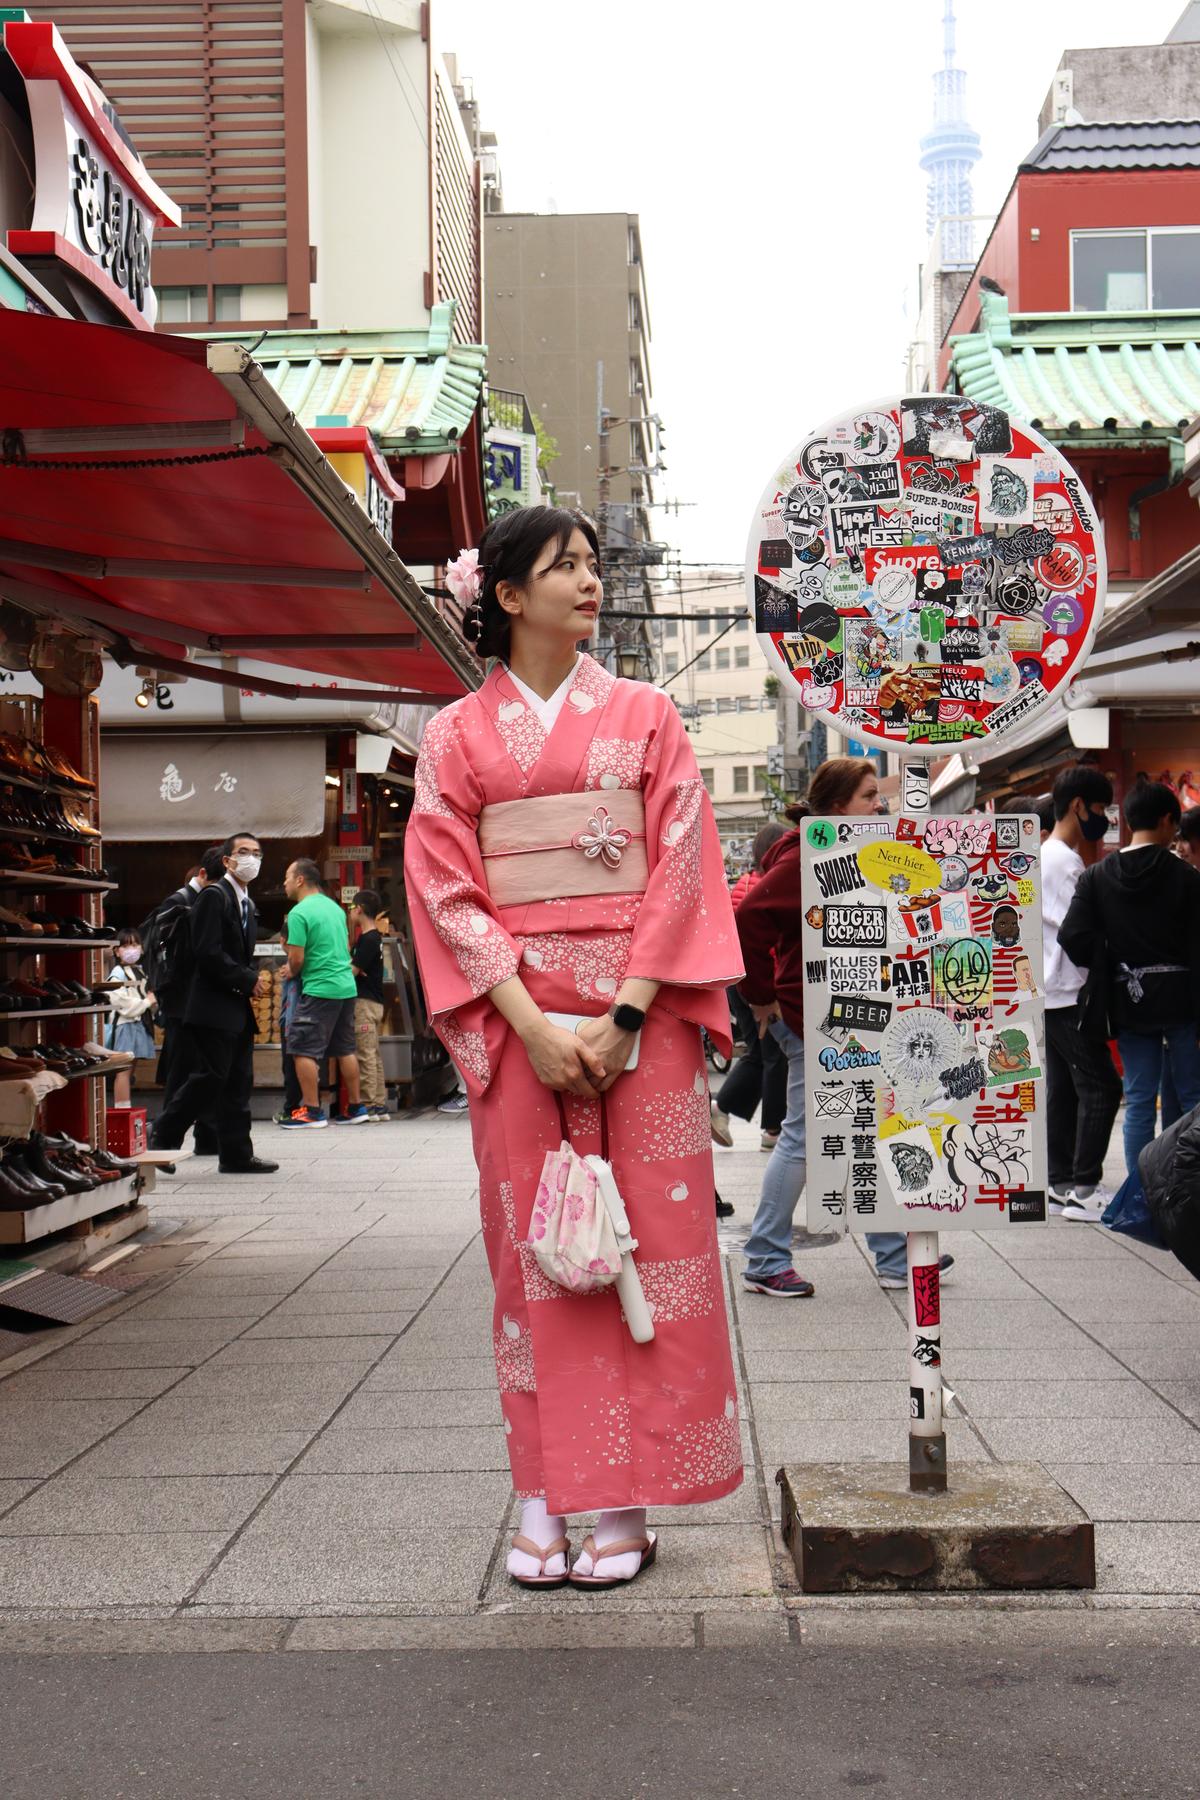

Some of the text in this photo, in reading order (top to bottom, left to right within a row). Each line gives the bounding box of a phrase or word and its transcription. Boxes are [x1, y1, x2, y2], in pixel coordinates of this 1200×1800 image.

[905, 491, 974, 514] SUPER-BOMBS
[944, 539, 993, 559] TENHALF
[1044, 555, 1072, 582] RAHU
[877, 848, 902, 864] Nett
[904, 855, 925, 871] hier.
[828, 908, 883, 926] BUGER
[828, 926, 884, 940] OCP AOD
[916, 932, 939, 944] TBRT
[829, 955, 878, 968] KLUES
[830, 968, 878, 980] MIGSY
[892, 959, 929, 987] AR
[830, 980, 878, 992] SPAZR
[845, 1004, 888, 1024] BEER
[1019, 1080, 1035, 1112] BARS
[820, 1079, 846, 1216] 草寺
